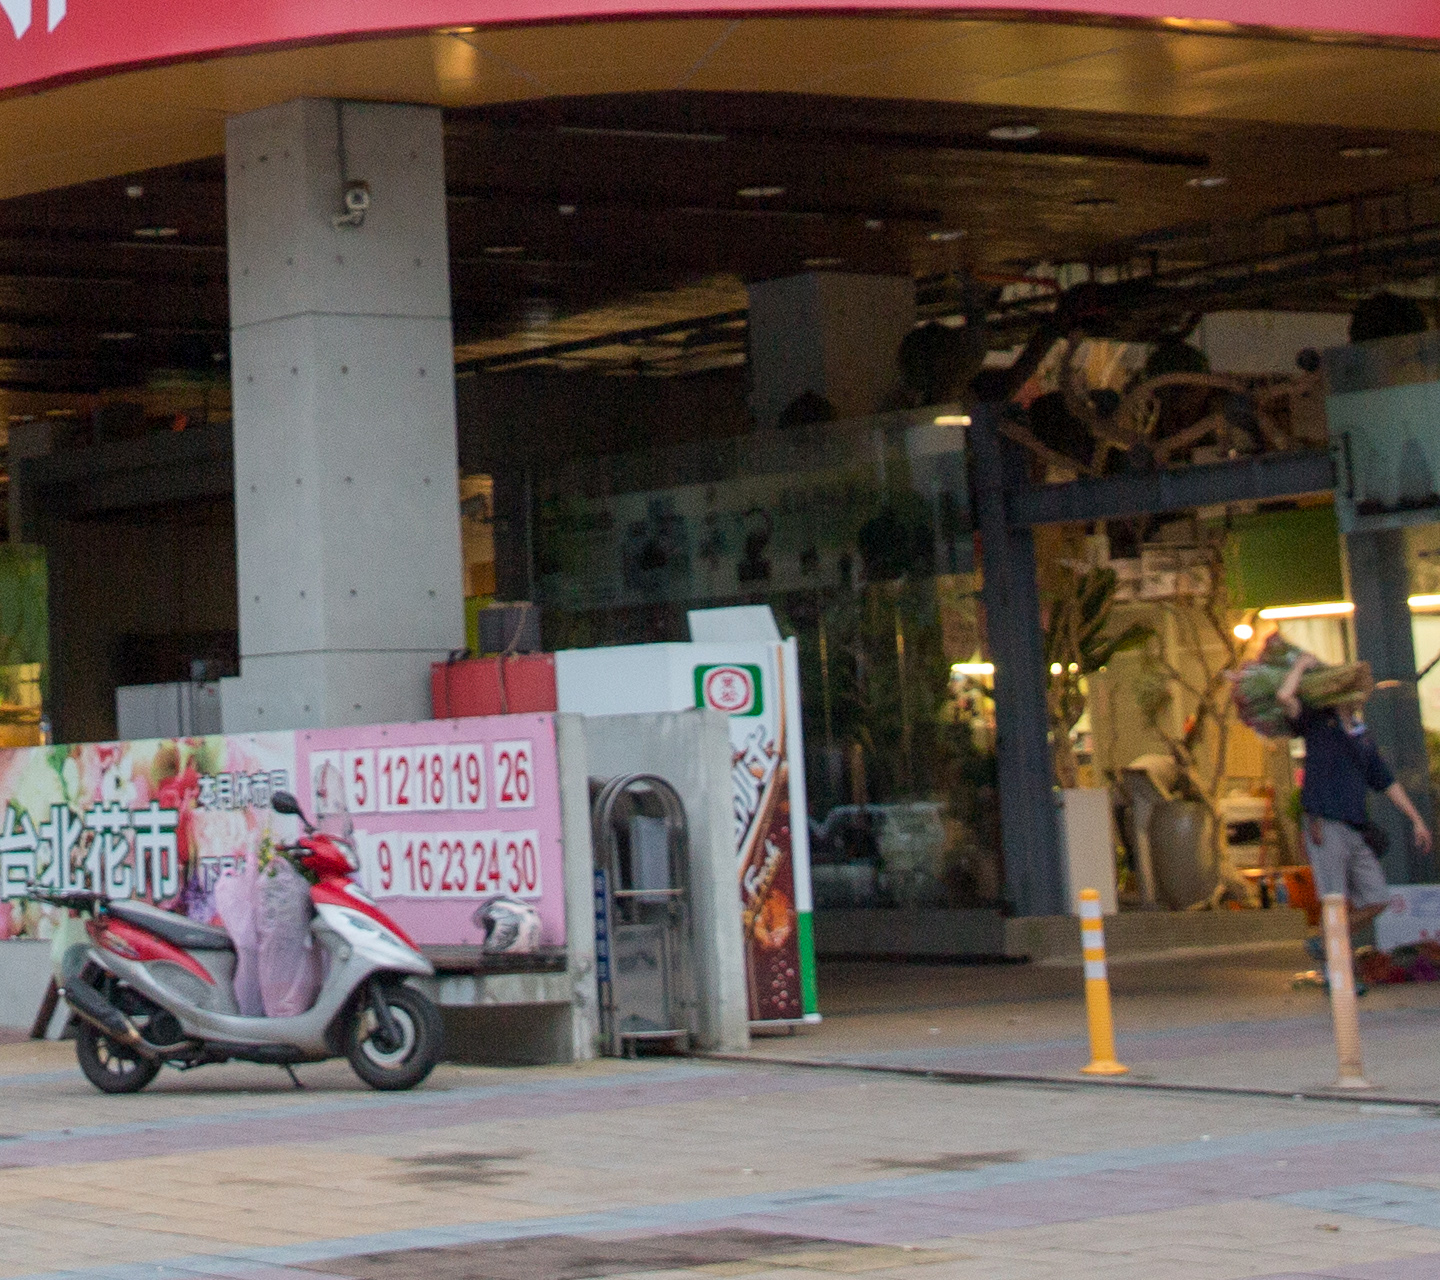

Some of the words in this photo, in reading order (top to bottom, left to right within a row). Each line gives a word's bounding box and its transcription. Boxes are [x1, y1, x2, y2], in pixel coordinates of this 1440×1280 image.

[354, 757, 368, 807] 5
[383, 755, 410, 806] 12
[417, 753, 445, 805] 18
[452, 752, 481, 805] 19
[498, 748, 531, 803] 26
[378, 841, 394, 891] 9
[405, 841, 434, 892] 16
[439, 841, 468, 892] 23
[472, 840, 501, 892] 24
[506, 839, 538, 892] 30
